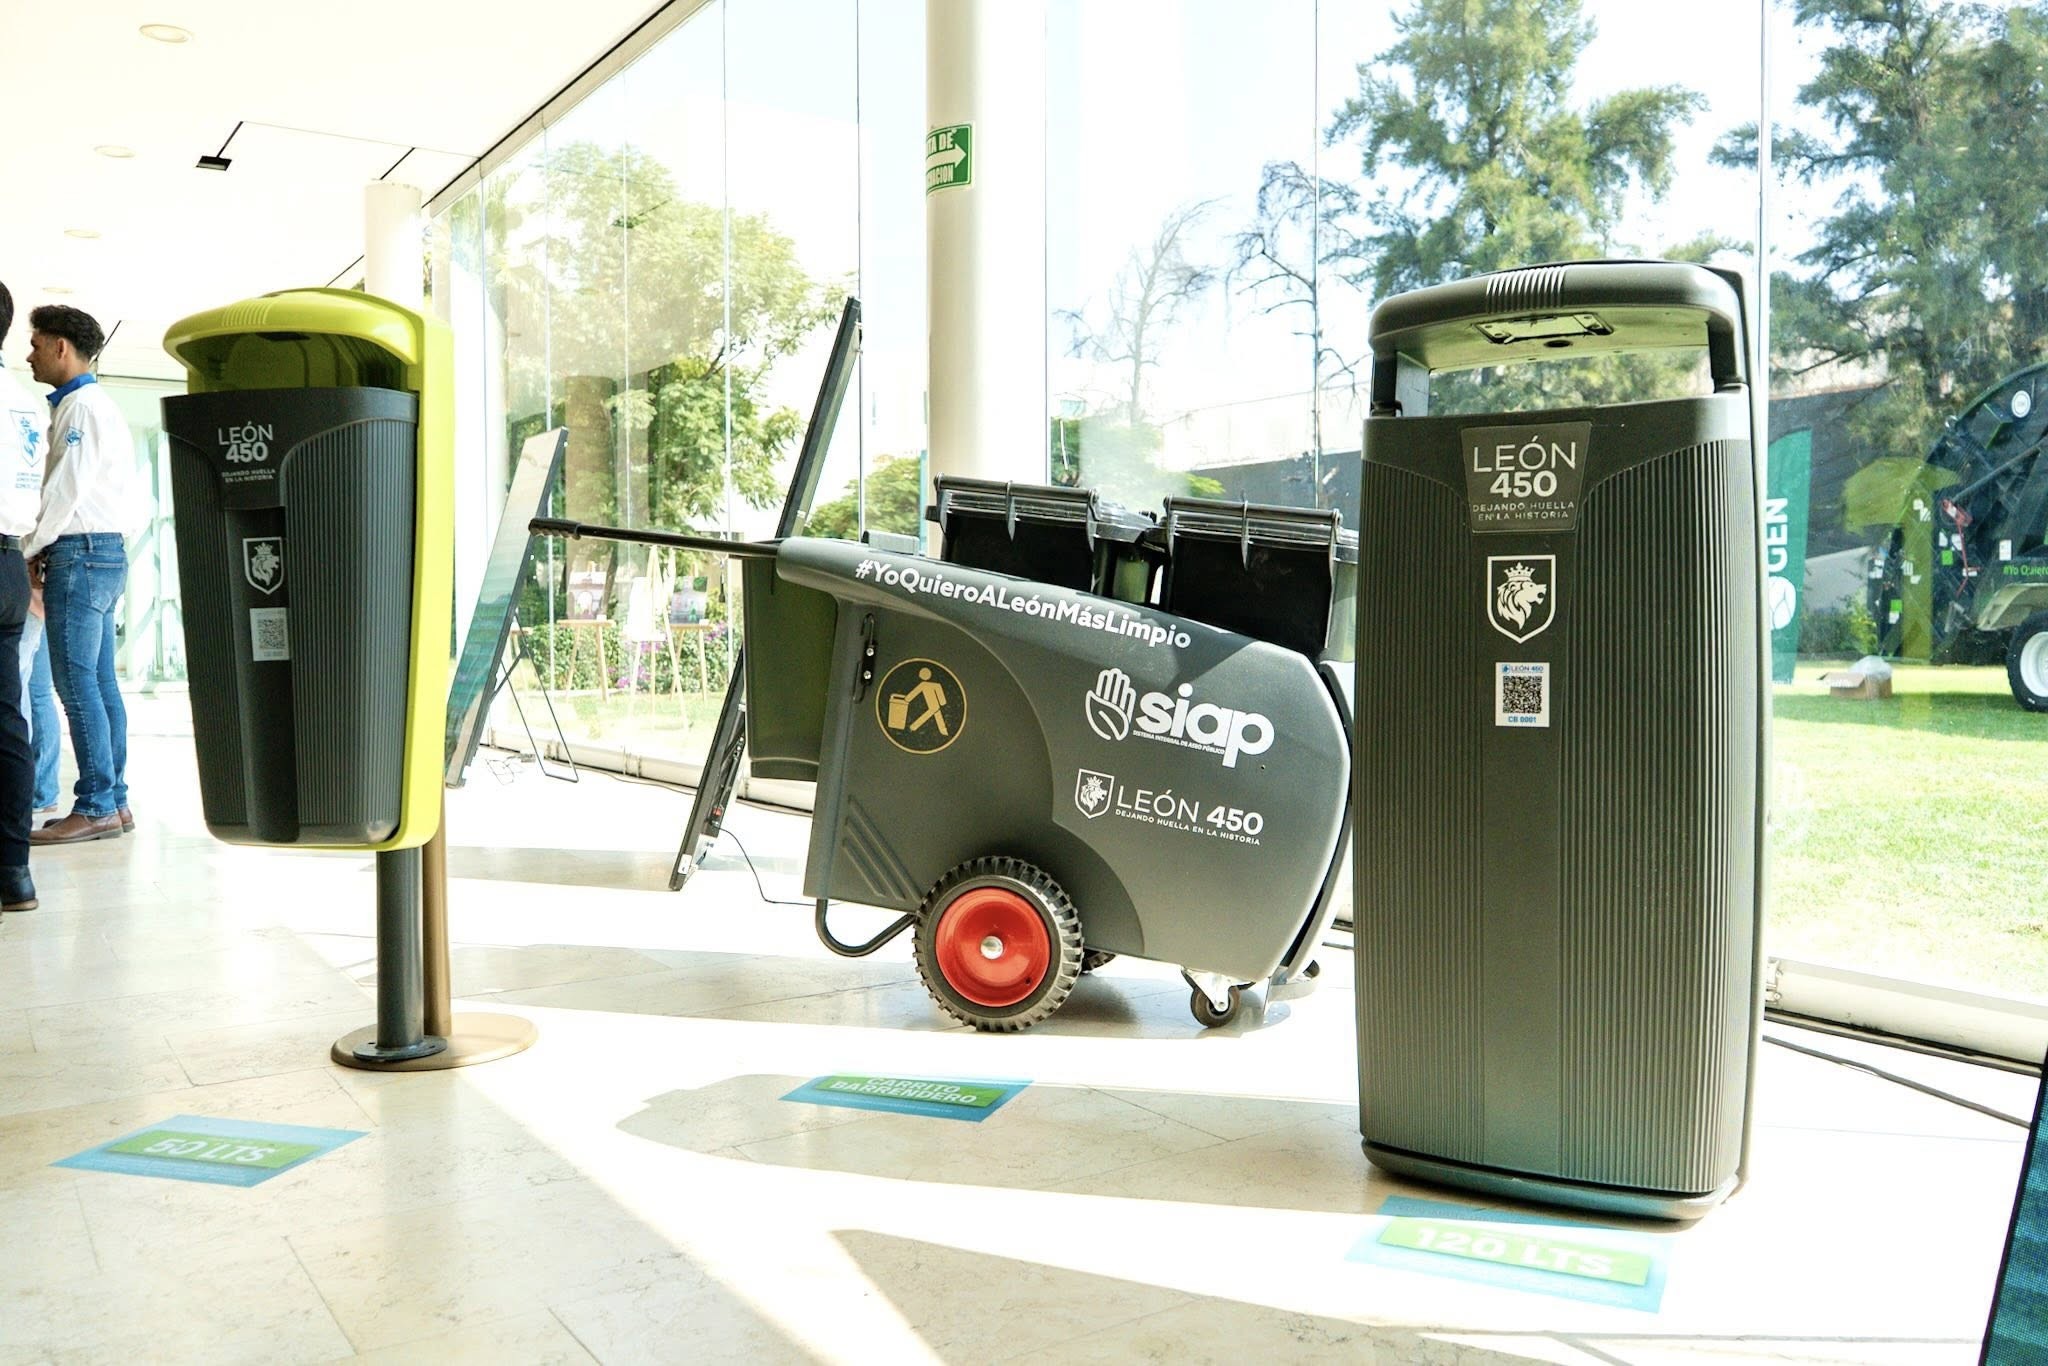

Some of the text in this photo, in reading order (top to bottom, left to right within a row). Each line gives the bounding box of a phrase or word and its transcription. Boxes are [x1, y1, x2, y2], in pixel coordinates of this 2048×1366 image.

[939, 132, 953, 150] DE
[218, 421, 274, 446] LEÓN
[225, 441, 269, 464] 450
[1473, 435, 1576, 473] LEÓN
[1489, 470, 1558, 498] 450
[1472, 501, 1575, 512] DEJANDO HUELLA
[1478, 510, 1569, 521] EN LA HISTORIA
[855, 558, 1192, 650] #YoQuieroALeónMásLimpio
[1136, 683, 1275, 769] siap
[1117, 785, 1264, 836] LEÓN 450
[1115, 809, 1261, 845] DEJANDO HUELLA EN LA HISTORIA
[830, 1081, 977, 1103] BARRENDERO
[867, 1077, 961, 1093] CARRITO
[1416, 1228, 1614, 1275] 120 LTS
